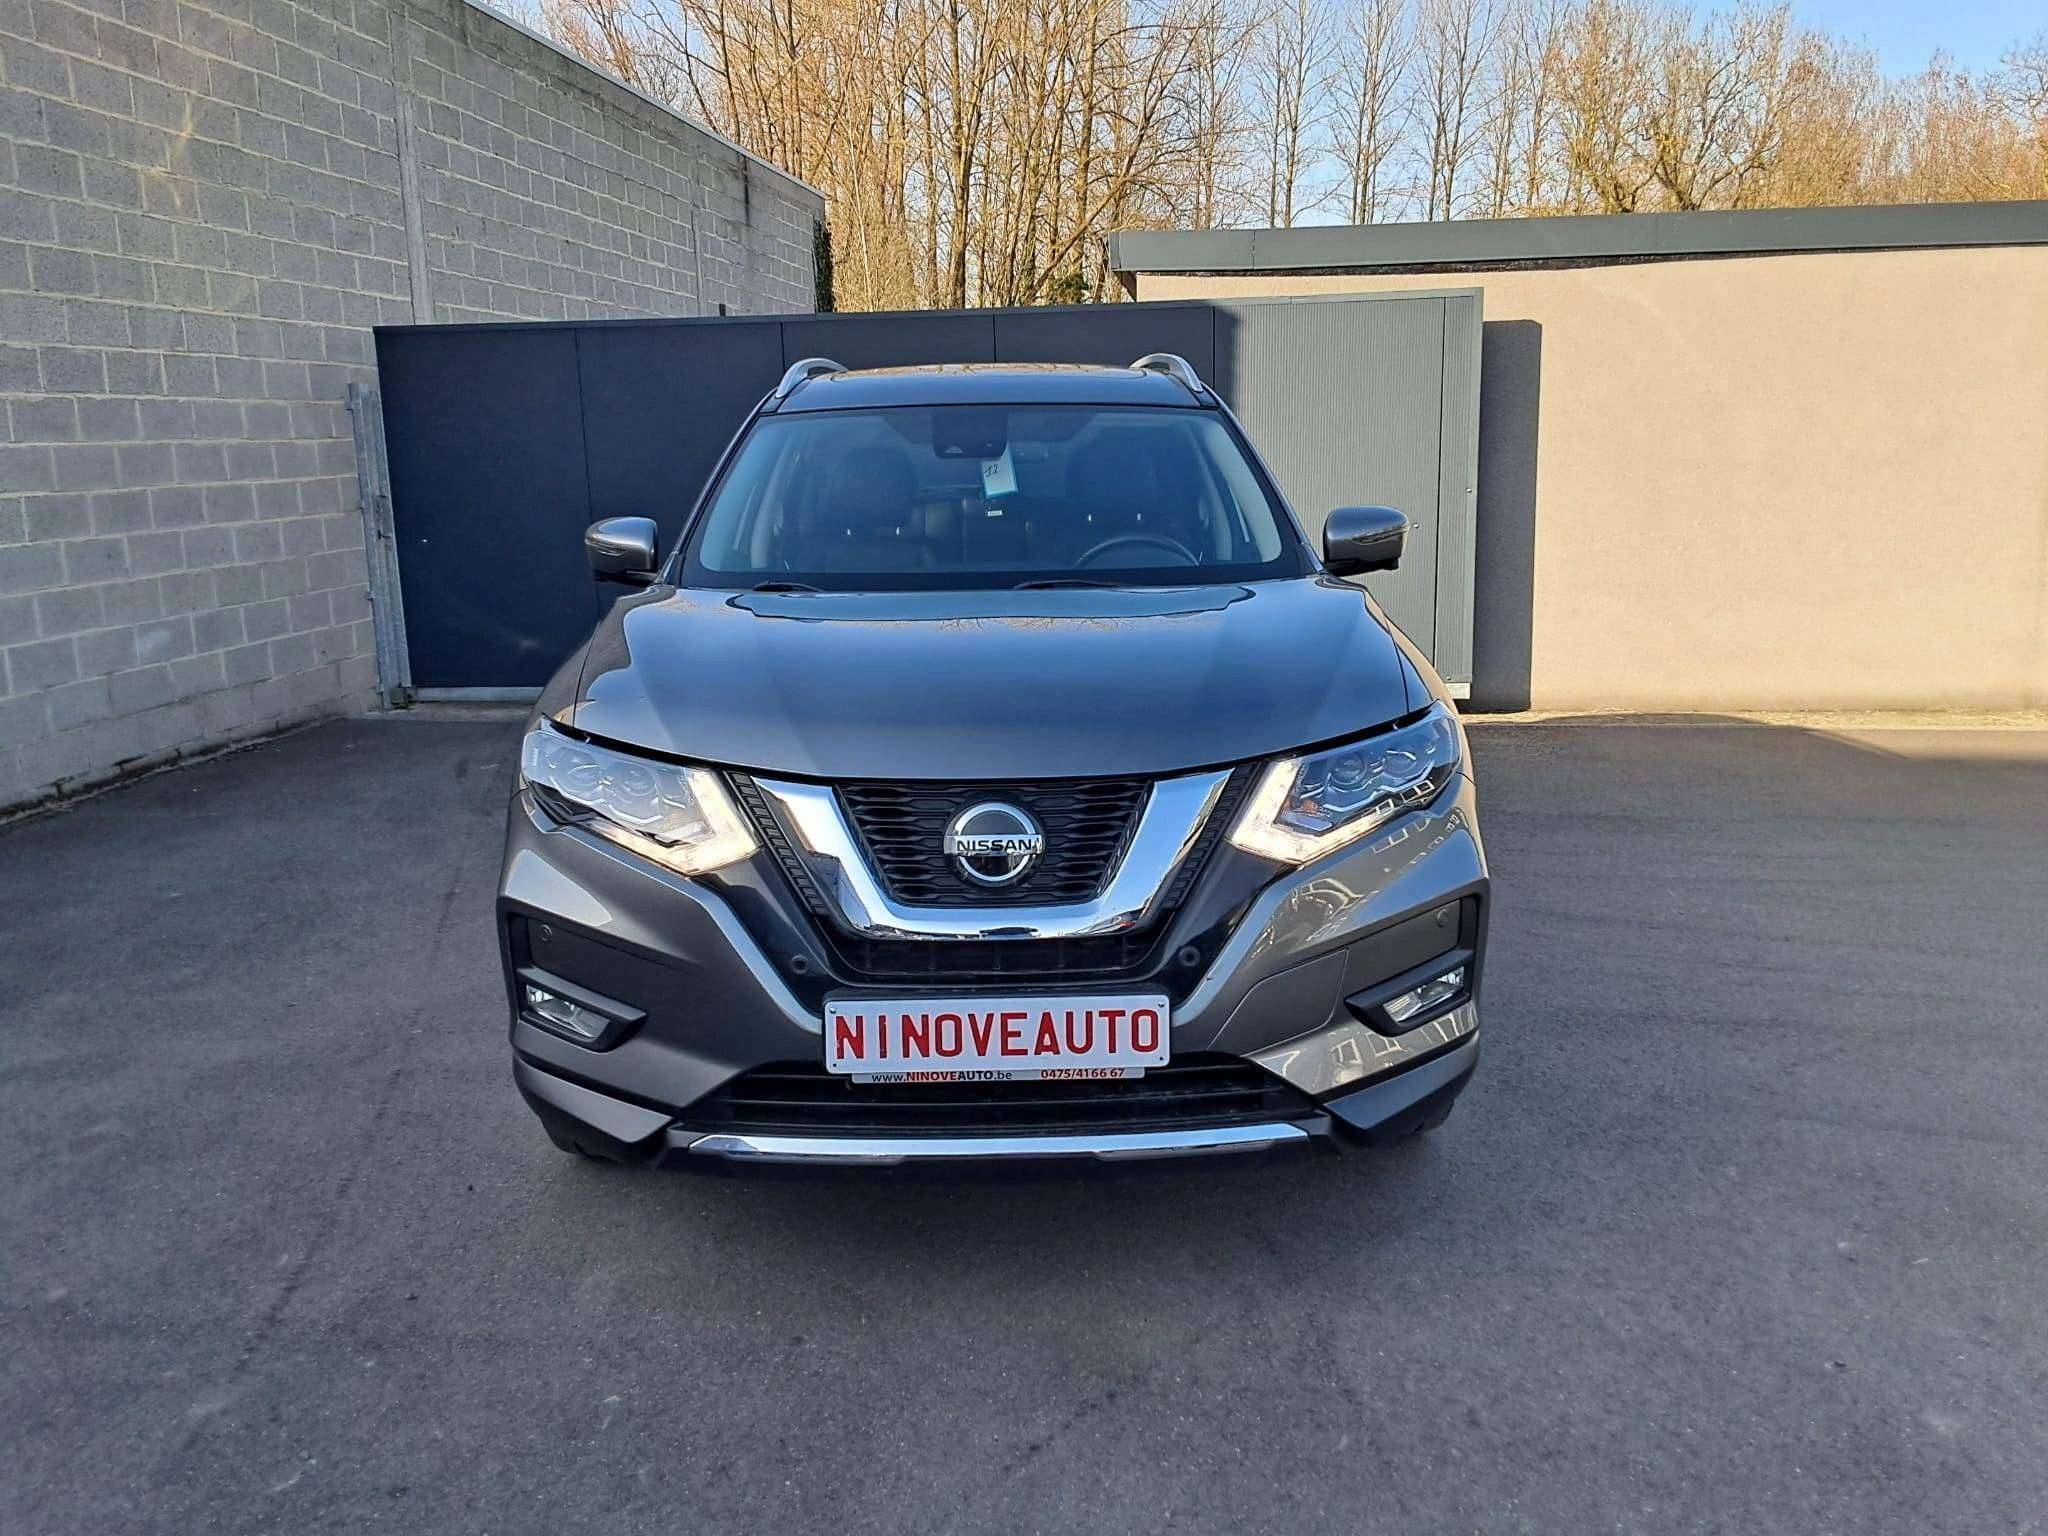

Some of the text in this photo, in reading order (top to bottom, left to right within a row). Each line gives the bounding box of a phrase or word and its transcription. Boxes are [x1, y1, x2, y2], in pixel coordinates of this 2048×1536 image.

[957, 839, 1032, 852] NISSAN
[835, 1009, 1159, 1060] NINOVEAUTO
[871, 1070, 1012, 1082] www.NINOVEAUTO.be
